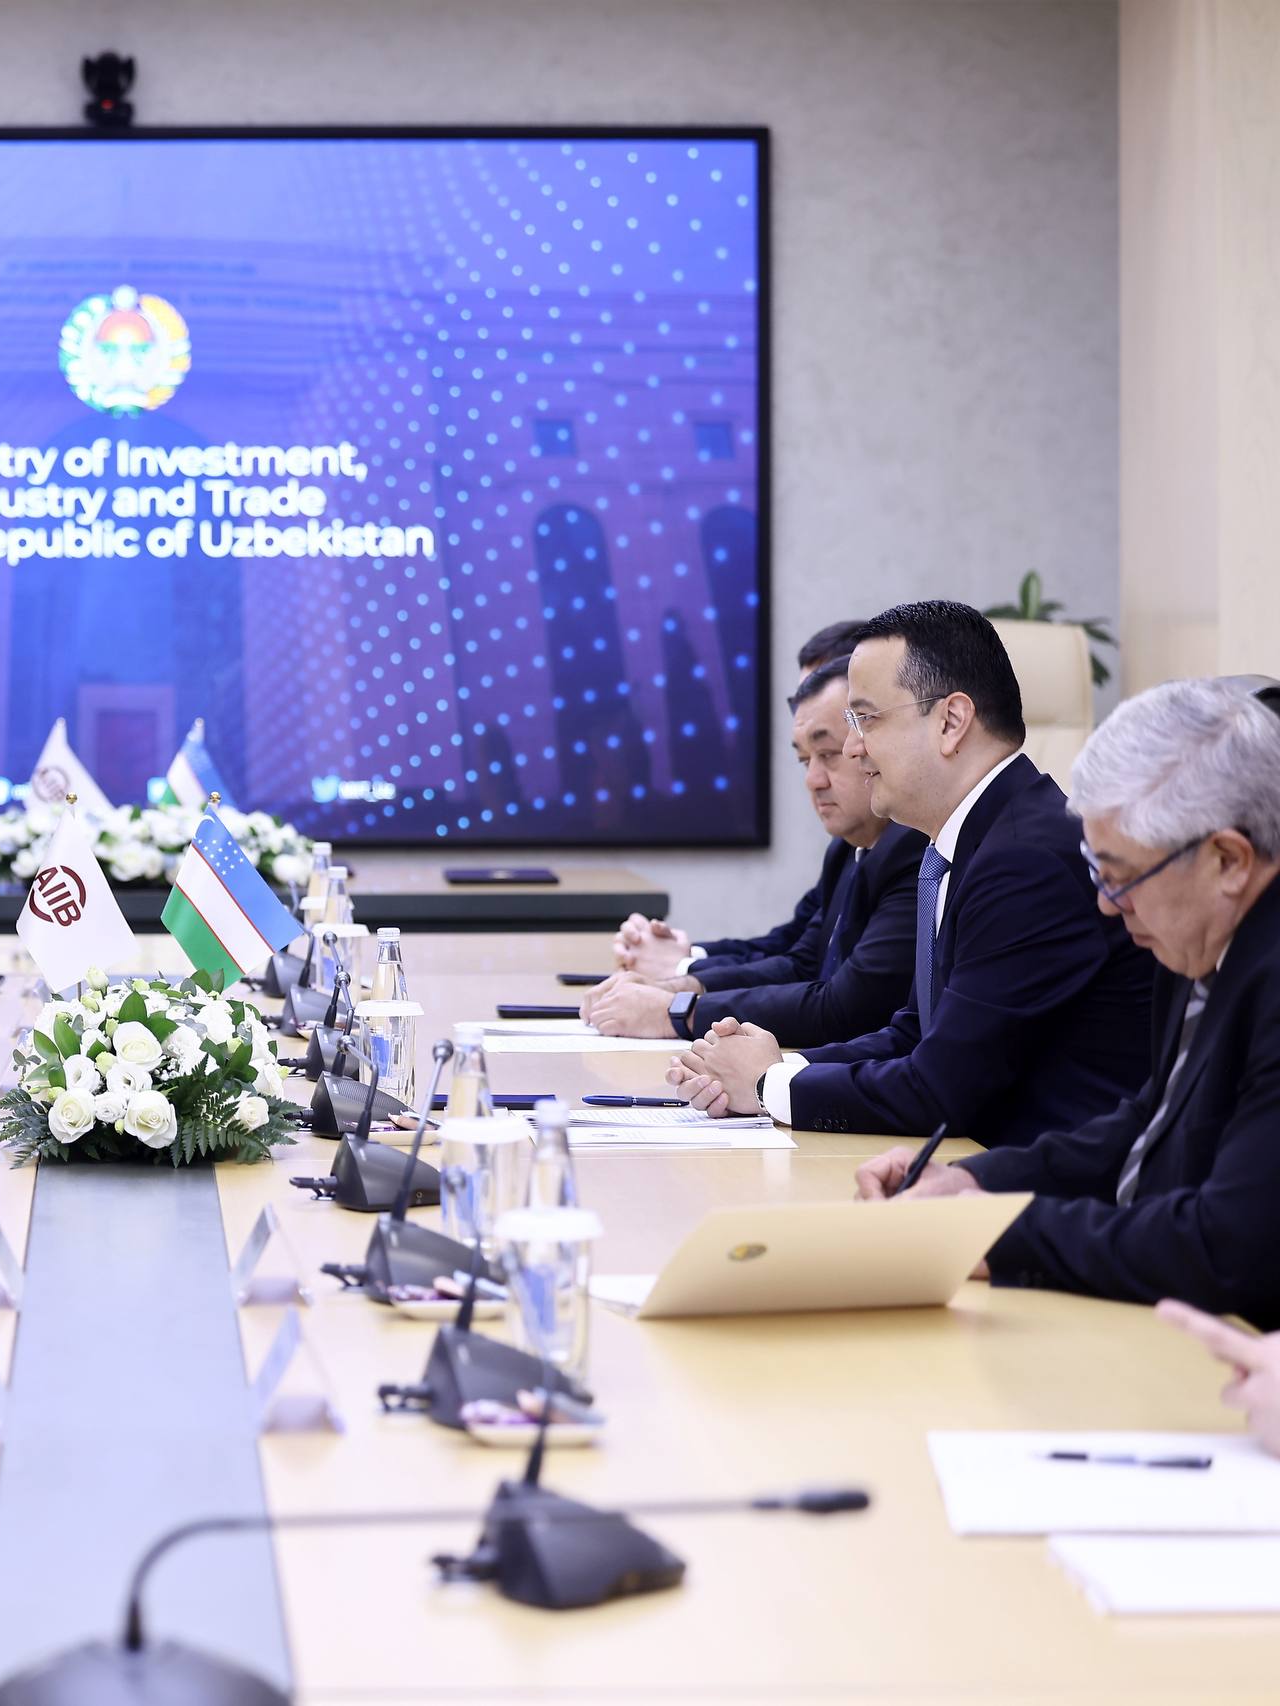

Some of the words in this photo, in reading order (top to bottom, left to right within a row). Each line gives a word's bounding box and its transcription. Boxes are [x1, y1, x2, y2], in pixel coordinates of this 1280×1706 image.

[63, 439, 110, 476] of
[116, 441, 368, 482] Investment,
[112, 480, 196, 517] and
[202, 479, 327, 517] Trade
[146, 519, 195, 557] of
[200, 518, 436, 558] Uzbekistan
[34, 866, 82, 927] AIIB
